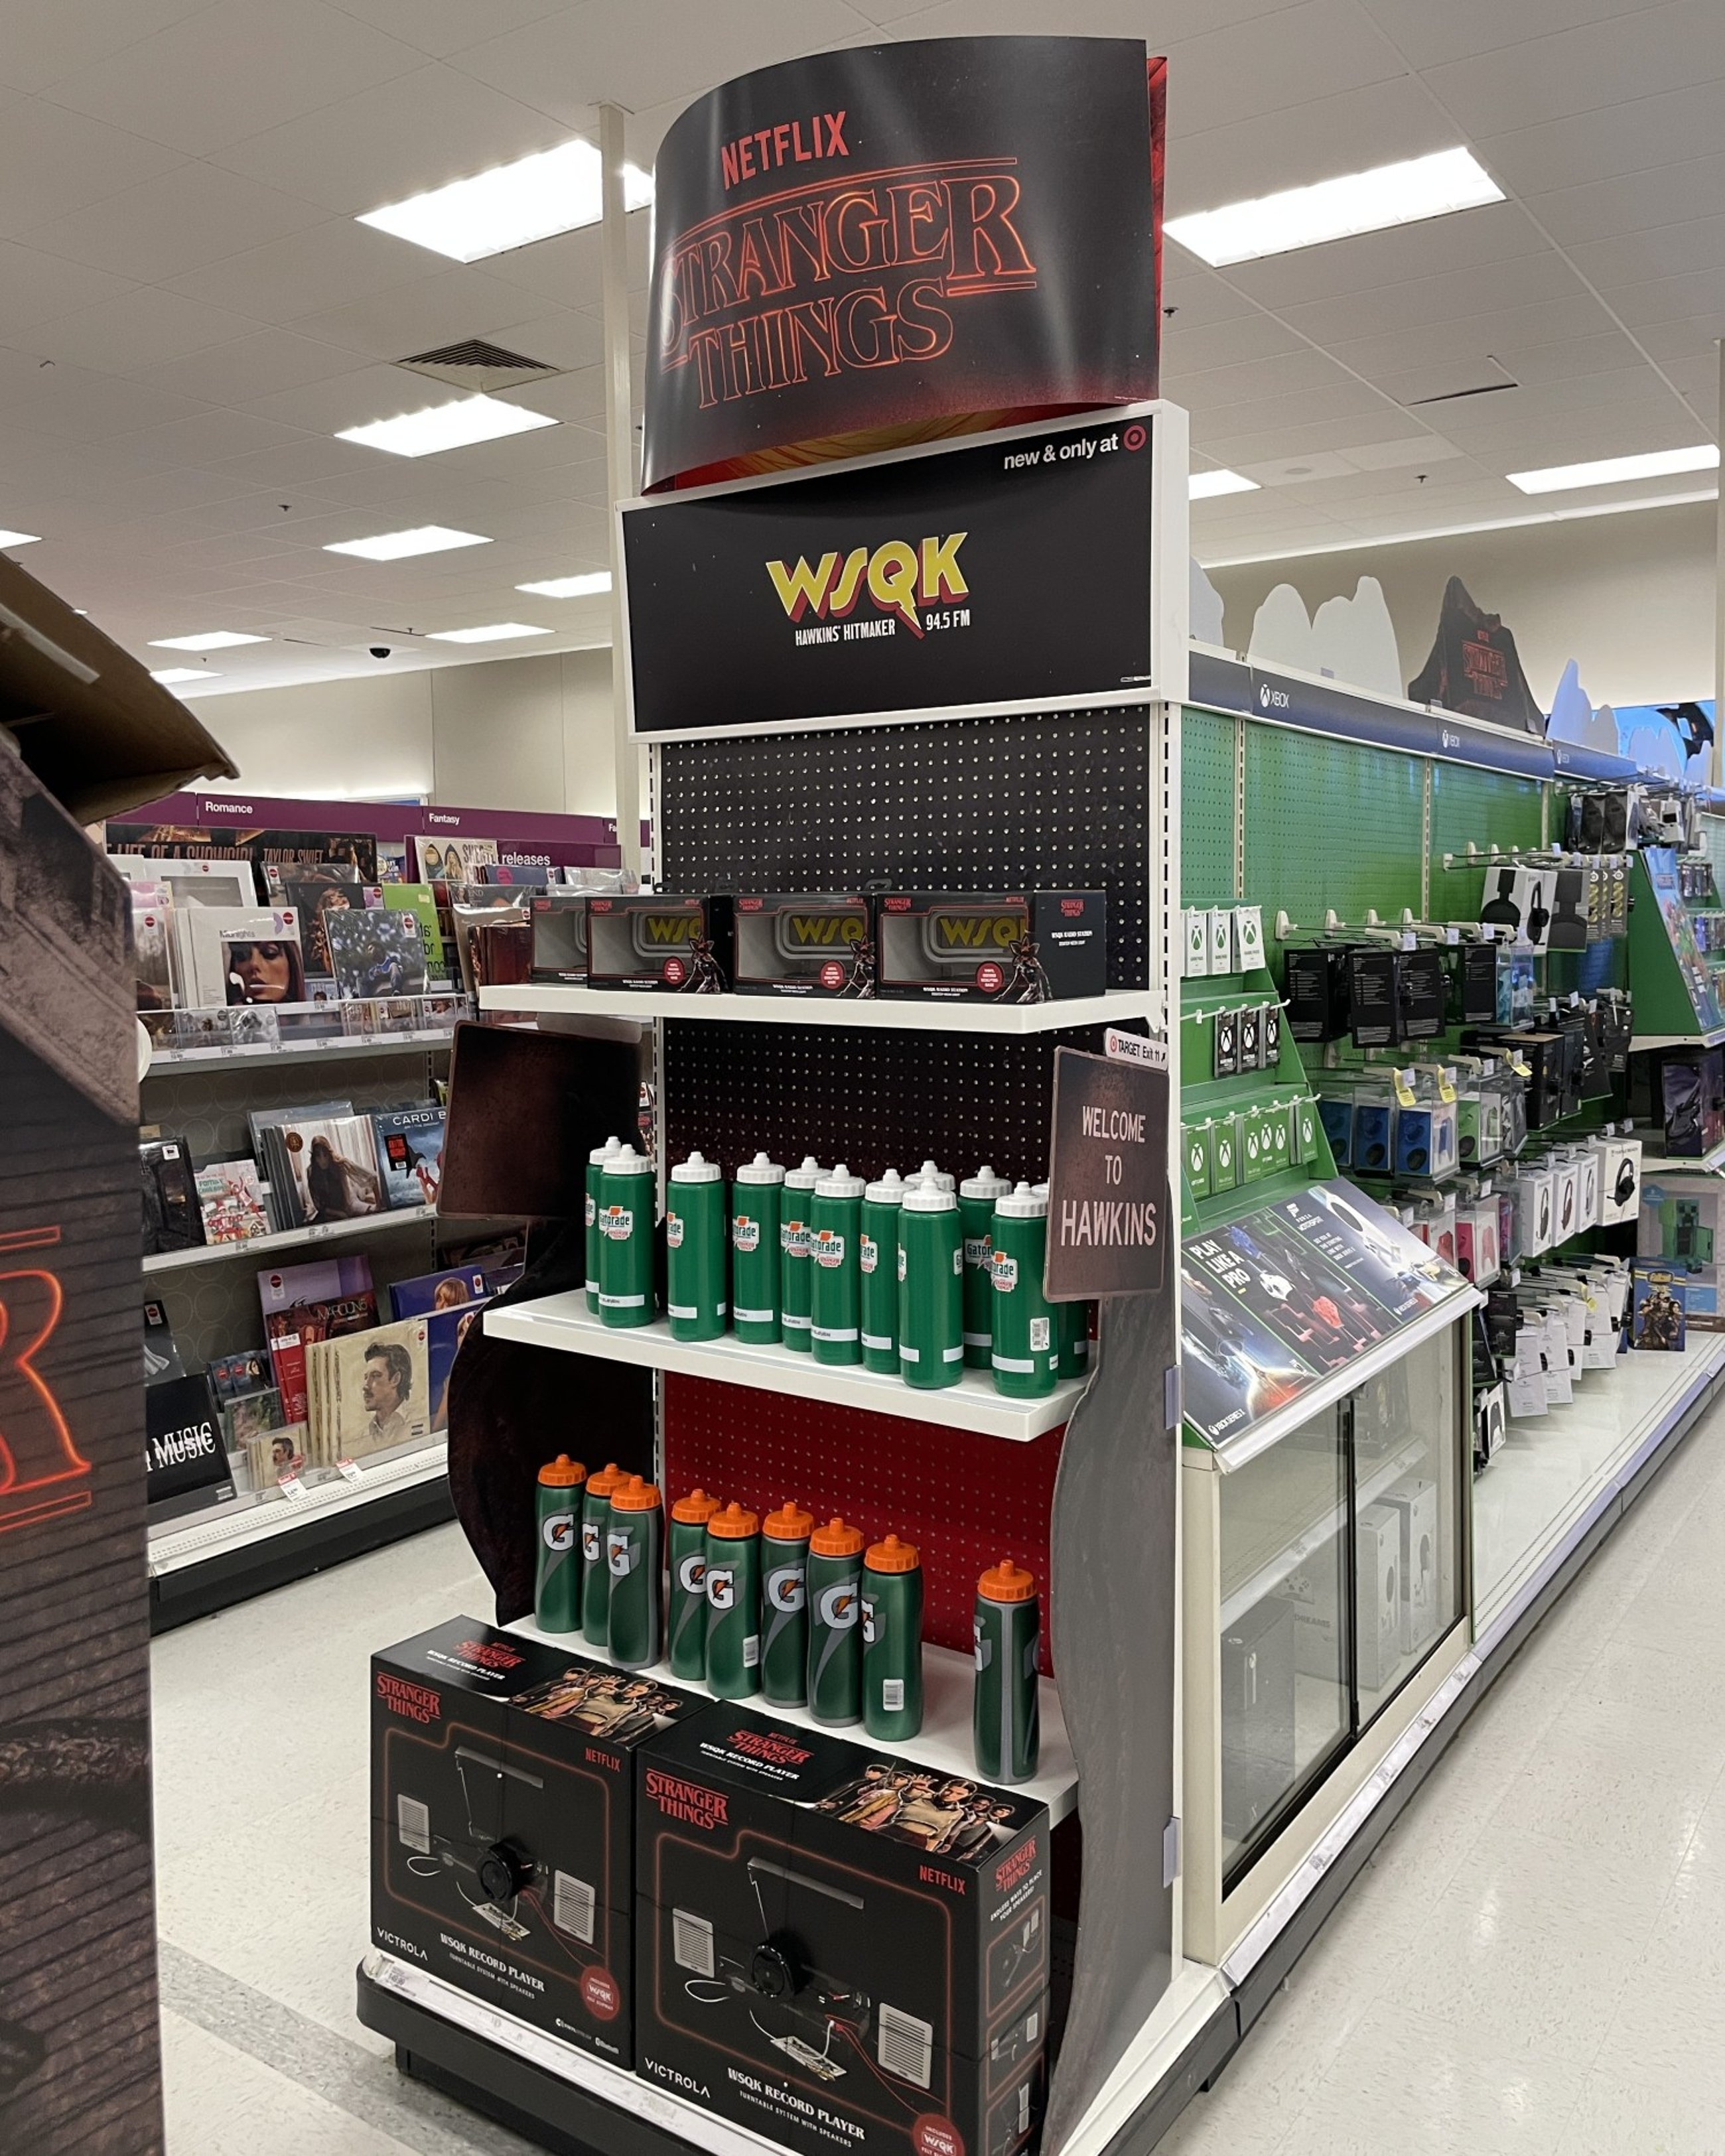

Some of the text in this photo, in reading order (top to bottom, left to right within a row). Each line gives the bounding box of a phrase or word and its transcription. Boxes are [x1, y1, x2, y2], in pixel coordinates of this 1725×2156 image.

[721, 111, 849, 190] NETFLIX
[659, 175, 1036, 357] STRANGER
[689, 279, 954, 409] THINGS
[1004, 433, 1119, 470] new & only at
[766, 532, 969, 634] WSQK
[843, 618, 896, 641] HITMAKER
[926, 612, 950, 631] 94.5
[953, 609, 971, 628] FM
[1270, 691, 1290, 709] XBOX
[206, 801, 253, 815] Romance
[429, 813, 460, 826] Fantasy
[264, 848, 294, 863] TAYLOR
[298, 849, 324, 864] SWIFT
[502, 852, 550, 866] releases
[792, 917, 863, 944] WSQ
[939, 917, 1026, 947] WSQ
[1118, 1039, 1140, 1057] TARGET
[1142, 1045, 1154, 1061] Exit
[393, 1111, 433, 1125] CARDI
[1082, 1105, 1146, 1144] WELCOME
[1105, 1154, 1122, 1185] TO
[1061, 1199, 1156, 1247] HAWKINS
[967, 1243, 992, 1256] Gator
[1189, 1239, 1222, 1260] PLAY
[1205, 1250, 1245, 1274] LIKE A
[1221, 1268, 1251, 1288] PRO
[152, 1422, 216, 1468] MUSIC
[377, 1675, 441, 1716] STRANGER
[386, 1695, 430, 1723] THINGS
[585, 1747, 621, 1773] NETFLIX
[700, 1742, 800, 1780] WSQK RECORD PLAYER
[731, 1731, 811, 1763] STRANGER
[734, 1742, 787, 1764] THINGS
[646, 1772, 728, 1822] STRANGER
[658, 1794, 715, 1830] THINGS
[919, 1864, 967, 1896] NETFLIX
[377, 1926, 429, 1962] VICTROLA
[441, 1932, 545, 1993] WSQK RECORD PLAYER
[645, 2056, 711, 2099] VICTROLA
[727, 2066, 865, 2140] WSQK RECORD PLAYER
[740, 2090, 852, 2148] TURNTABLE SYSTEM WITH SPEAKERS
[924, 2133, 953, 2155] WSQK
